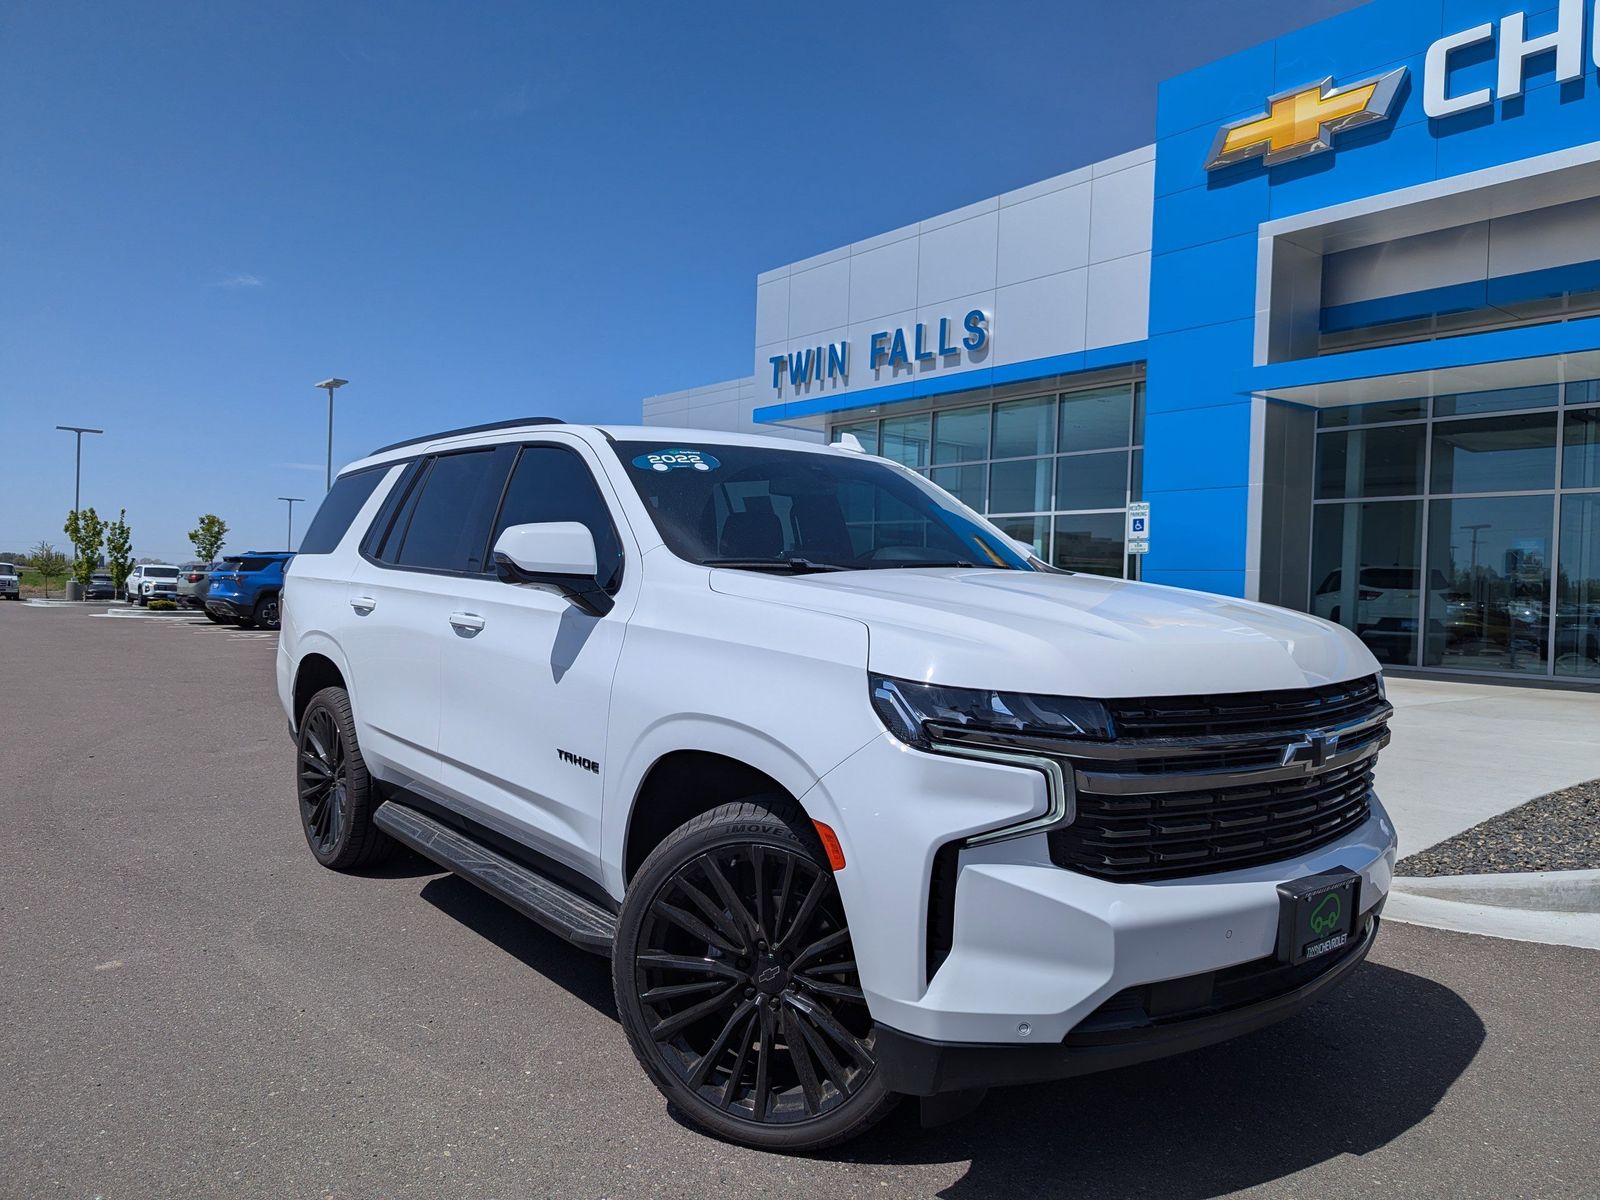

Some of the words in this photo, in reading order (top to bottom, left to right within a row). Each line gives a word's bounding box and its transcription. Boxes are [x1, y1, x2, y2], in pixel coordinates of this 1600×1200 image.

[1423, 0, 1600, 118] CH
[769, 341, 849, 389] TWIN
[870, 309, 988, 370] FALLS
[647, 454, 704, 464] 2022
[556, 748, 600, 775] TAHOE
